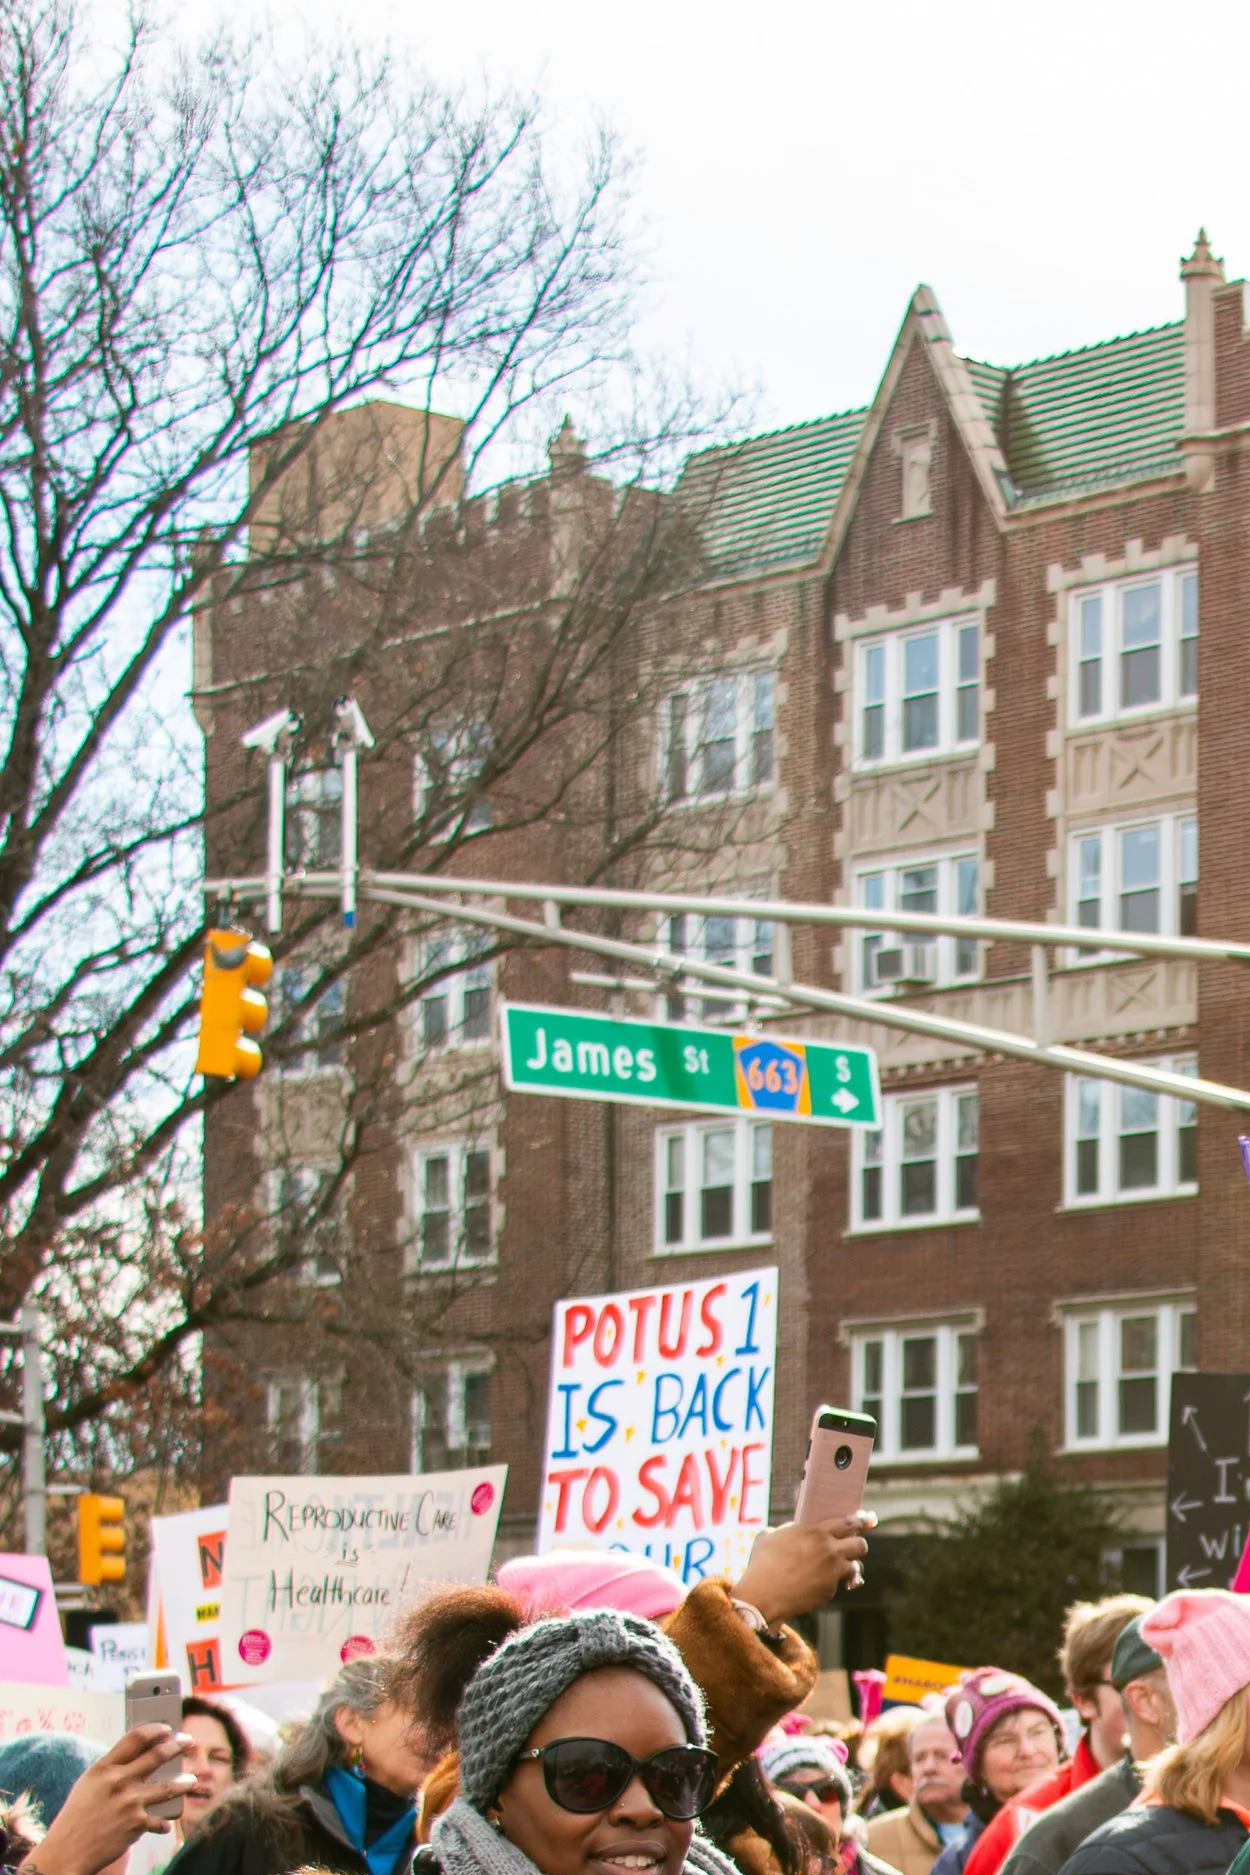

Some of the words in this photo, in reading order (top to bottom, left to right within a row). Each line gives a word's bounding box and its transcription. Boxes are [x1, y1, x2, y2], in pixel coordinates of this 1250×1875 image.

[527, 1027, 657, 1082] James
[684, 1045, 710, 1075] St
[748, 1057, 798, 1095] 663
[835, 1056, 852, 1083] S
[563, 1283, 727, 1368] POTUS
[735, 1281, 760, 1356] 1
[551, 1379, 625, 1459] IS
[652, 1366, 771, 1444] BACK
[263, 1490, 409, 1542] REPRODUCTIVE
[416, 1490, 457, 1536] CARE
[548, 1467, 621, 1535] TO
[632, 1442, 765, 1531] SAVE
